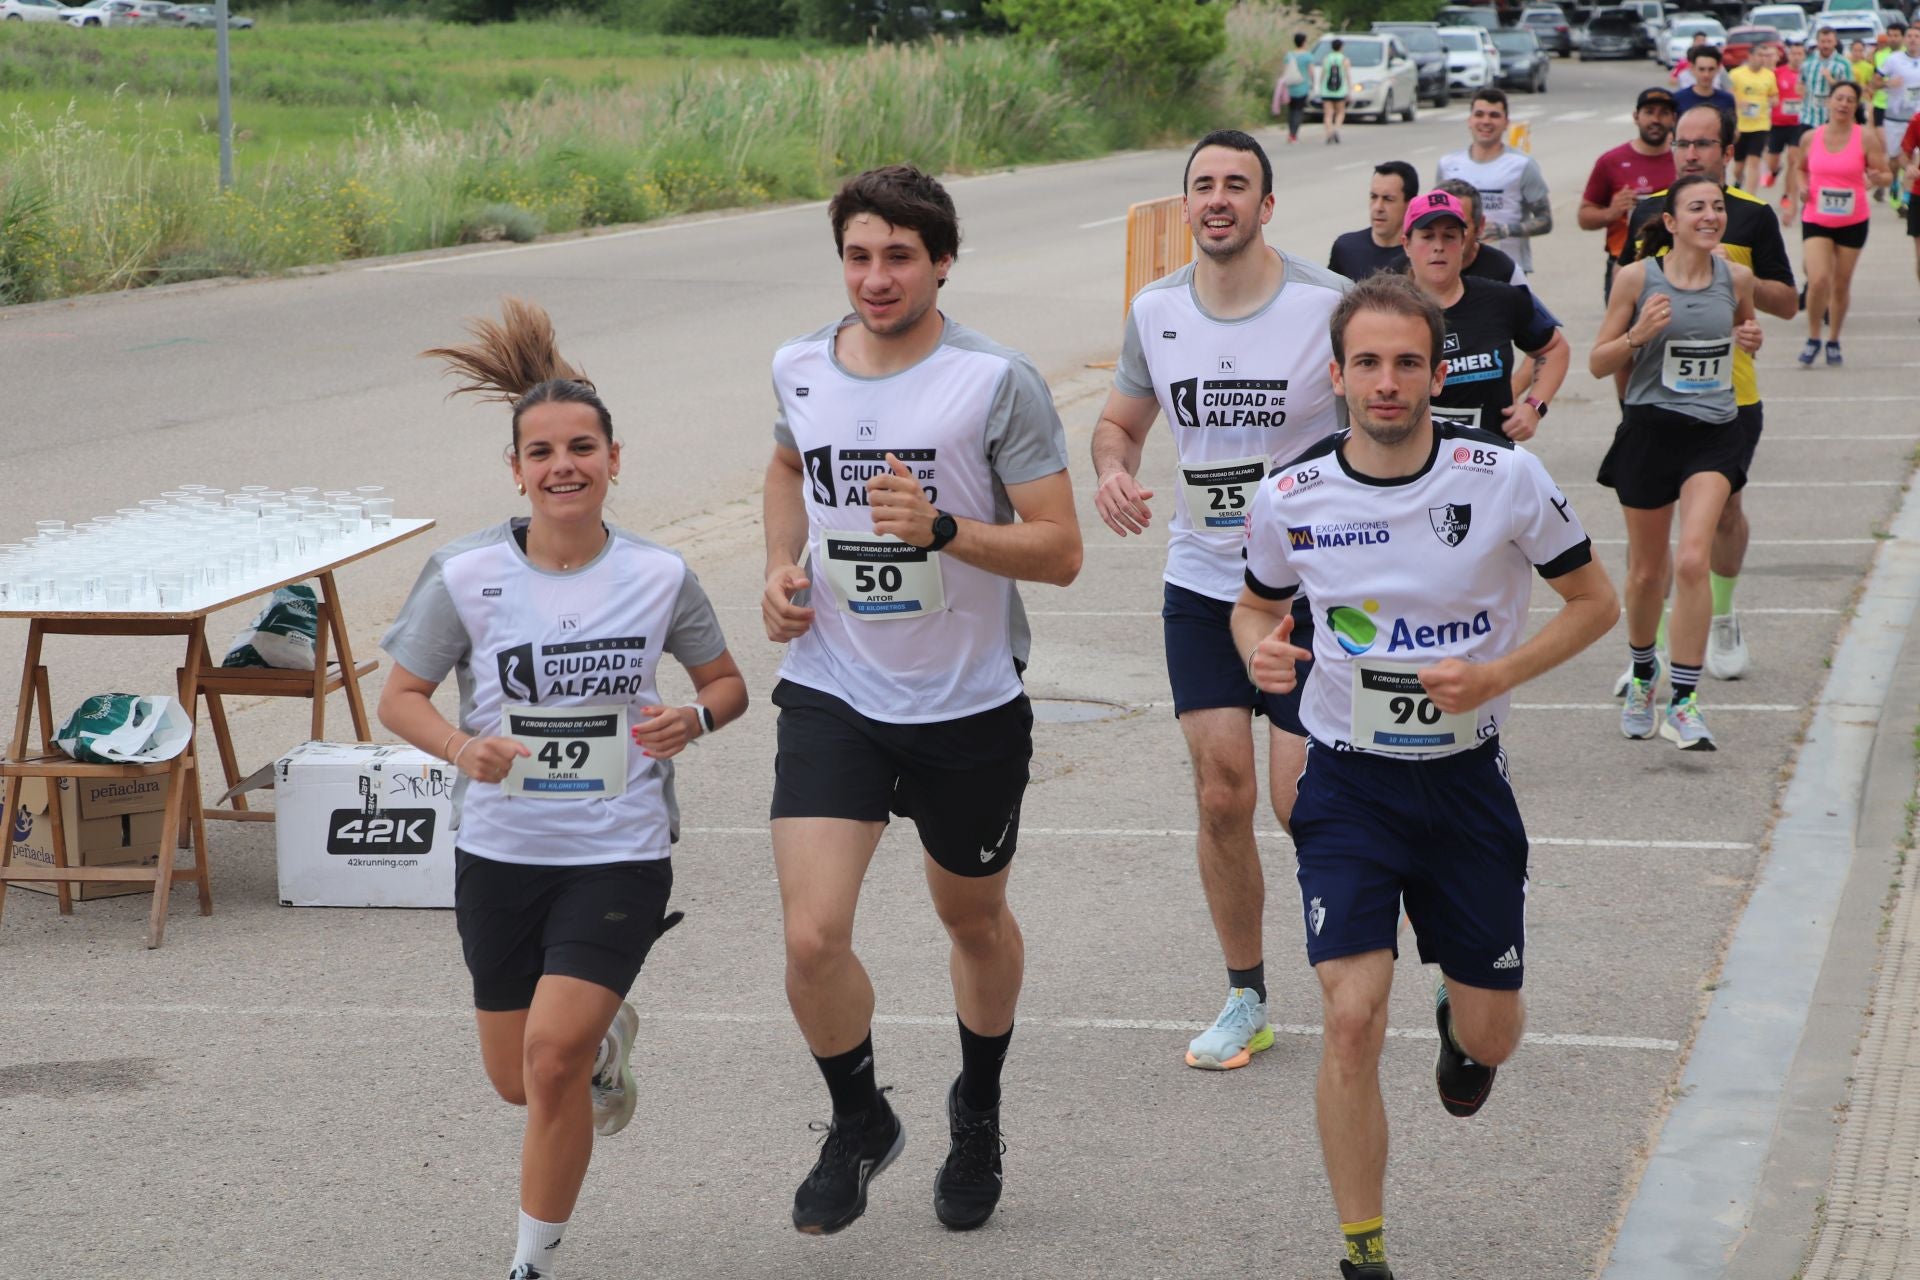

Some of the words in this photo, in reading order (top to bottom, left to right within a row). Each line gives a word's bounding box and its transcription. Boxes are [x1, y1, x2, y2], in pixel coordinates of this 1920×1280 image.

[1824, 197, 1848, 207] 517
[1446, 353, 1493, 373] SHER
[1678, 359, 1720, 376] 511
[1203, 393, 1266, 407] CIUDAD
[1271, 397, 1285, 405] DE
[1205, 410, 1286, 427] ALFARO
[1472, 449, 1498, 466] BS
[918, 470, 935, 479] DE
[1297, 466, 1320, 484] BS
[1451, 465, 1494, 475] edulcorantes
[1207, 486, 1245, 510] 25
[1315, 522, 1389, 534] EXCAVACIONES
[1317, 530, 1390, 548] MAPILO
[856, 565, 902, 592] 50
[1387, 610, 1492, 652] Aema
[586, 641, 640, 649] CROSS
[544, 654, 626, 677] CIUDAD
[630, 657, 643, 668] DE
[549, 674, 642, 697] ALFARO
[1377, 676, 1400, 684] CROSS
[1389, 696, 1442, 724] 90
[525, 720, 548, 728] CROSS
[538, 740, 591, 769] 49
[90, 779, 160, 801] peñaclara
[336, 819, 427, 844] 42K
[347, 858, 418, 868] 42krunning.com
[1493, 959, 1520, 969] adidas
